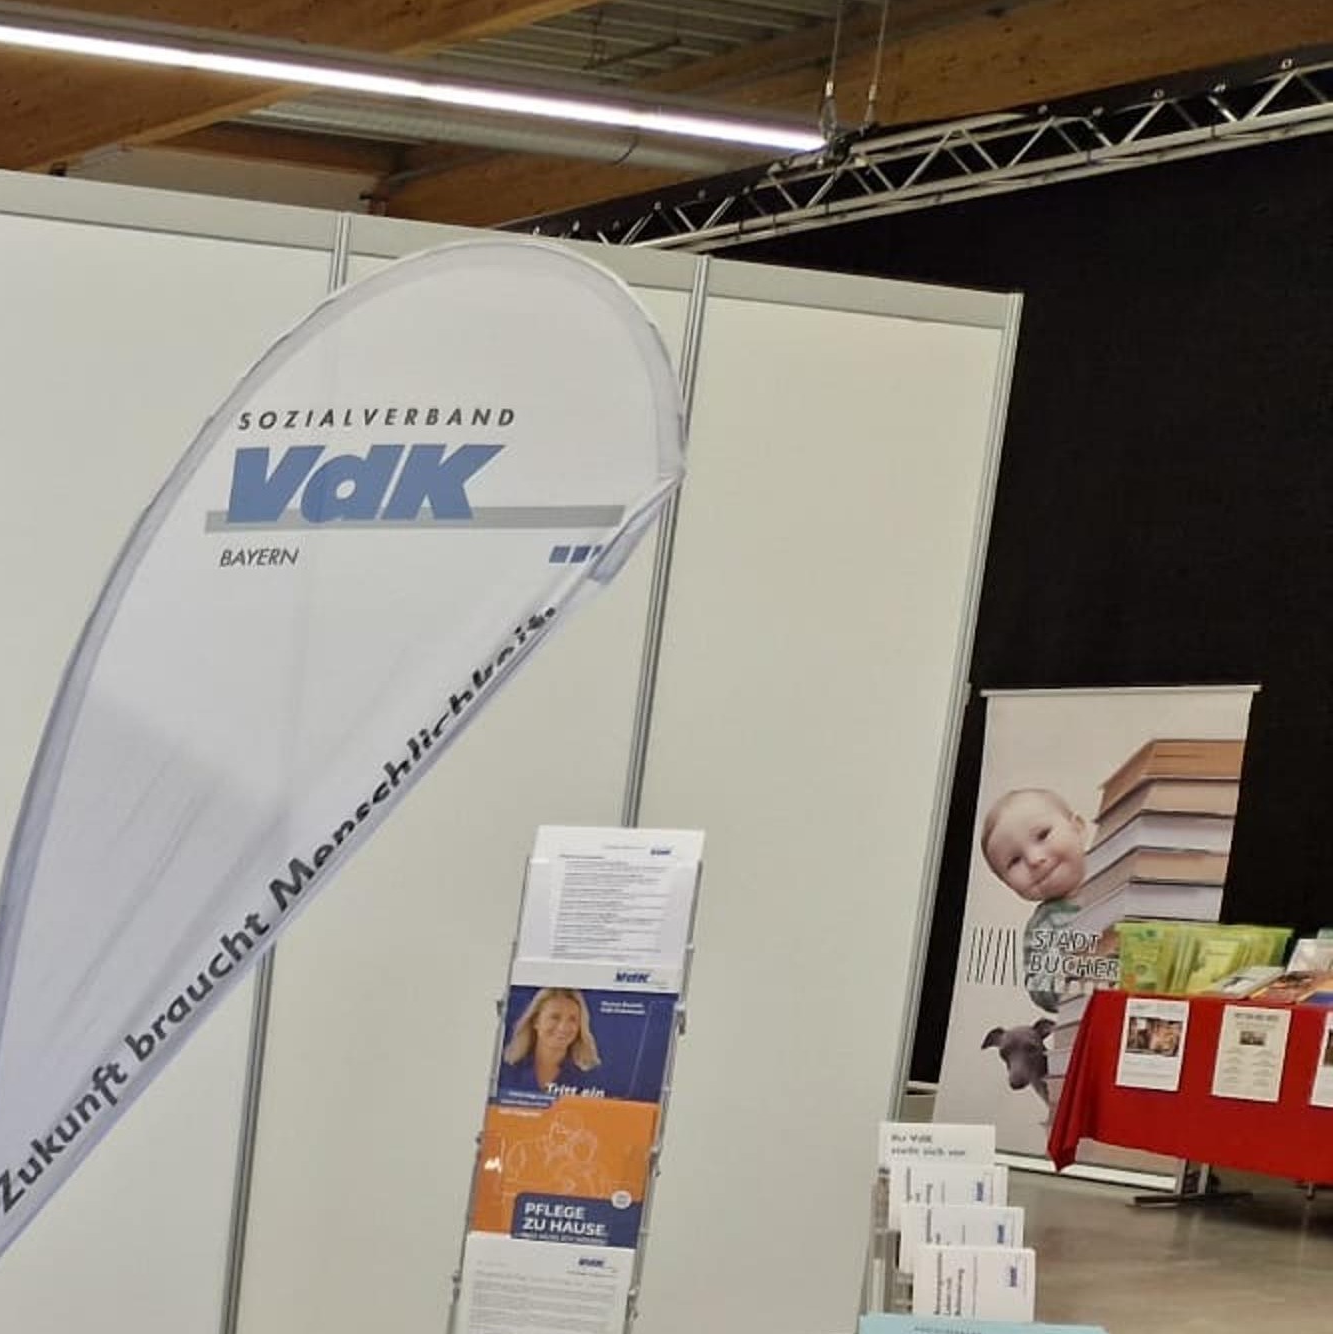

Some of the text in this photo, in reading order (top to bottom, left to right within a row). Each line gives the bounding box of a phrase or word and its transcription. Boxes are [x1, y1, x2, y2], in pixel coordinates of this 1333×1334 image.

[238, 407, 516, 431] SOZIALVERBAND
[227, 443, 506, 524] VdK
[219, 547, 300, 568] BAYERN
[124, 912, 270, 1062] braucht
[524, 1202, 586, 1220] PFLEGE
[523, 1217, 607, 1237] ZU HAUSE
